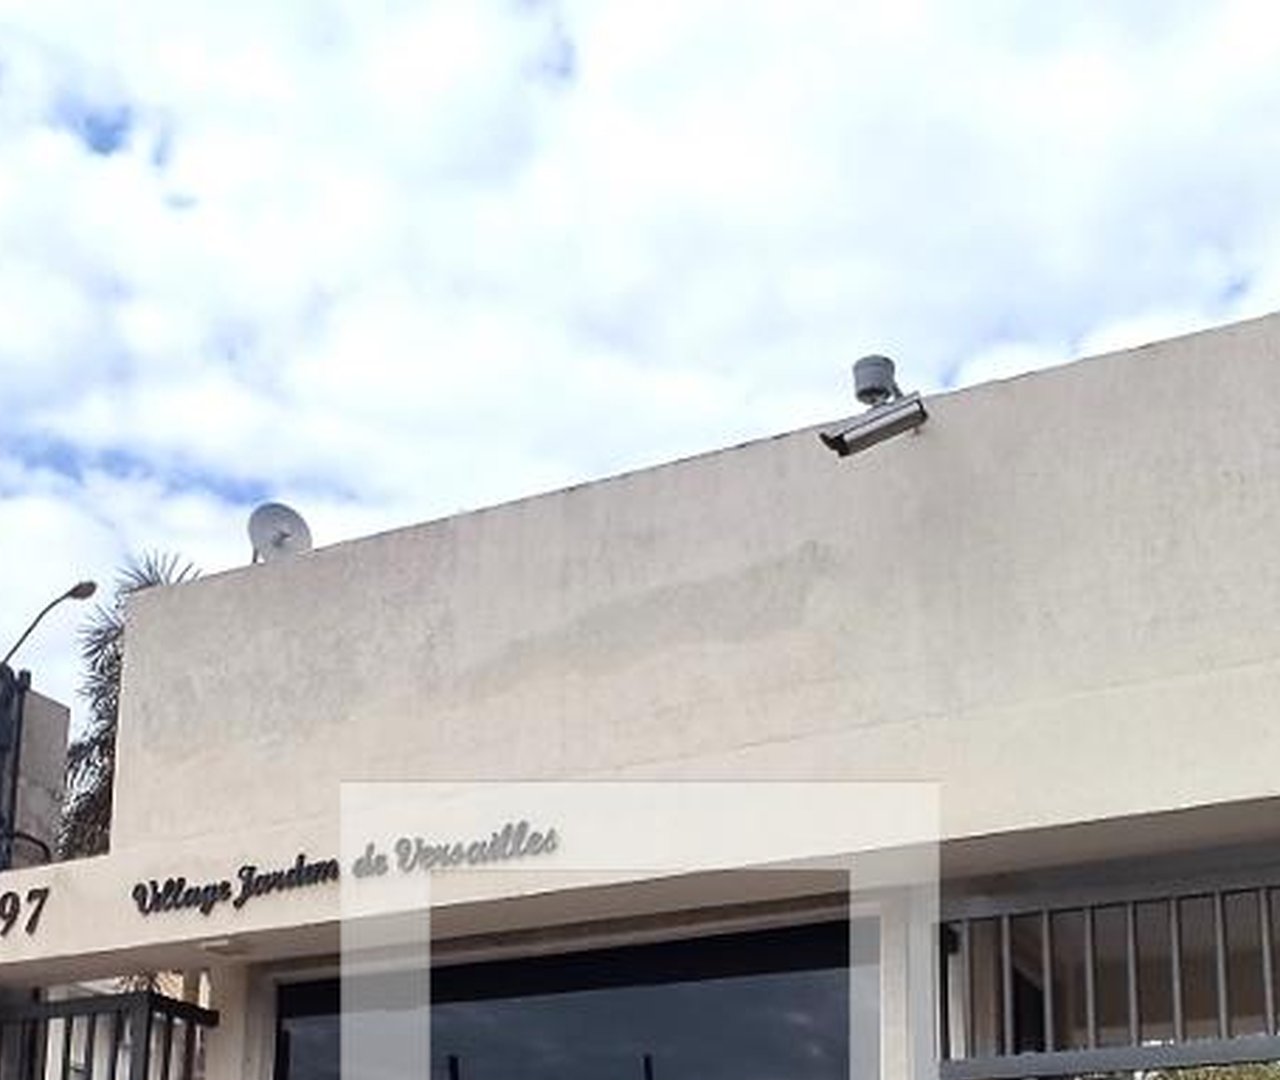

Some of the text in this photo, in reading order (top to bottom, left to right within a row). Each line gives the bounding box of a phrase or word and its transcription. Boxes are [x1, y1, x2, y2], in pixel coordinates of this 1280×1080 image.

[132, 877, 232, 916] Village
[352, 843, 389, 878] de
[395, 819, 558, 873] Versailles
